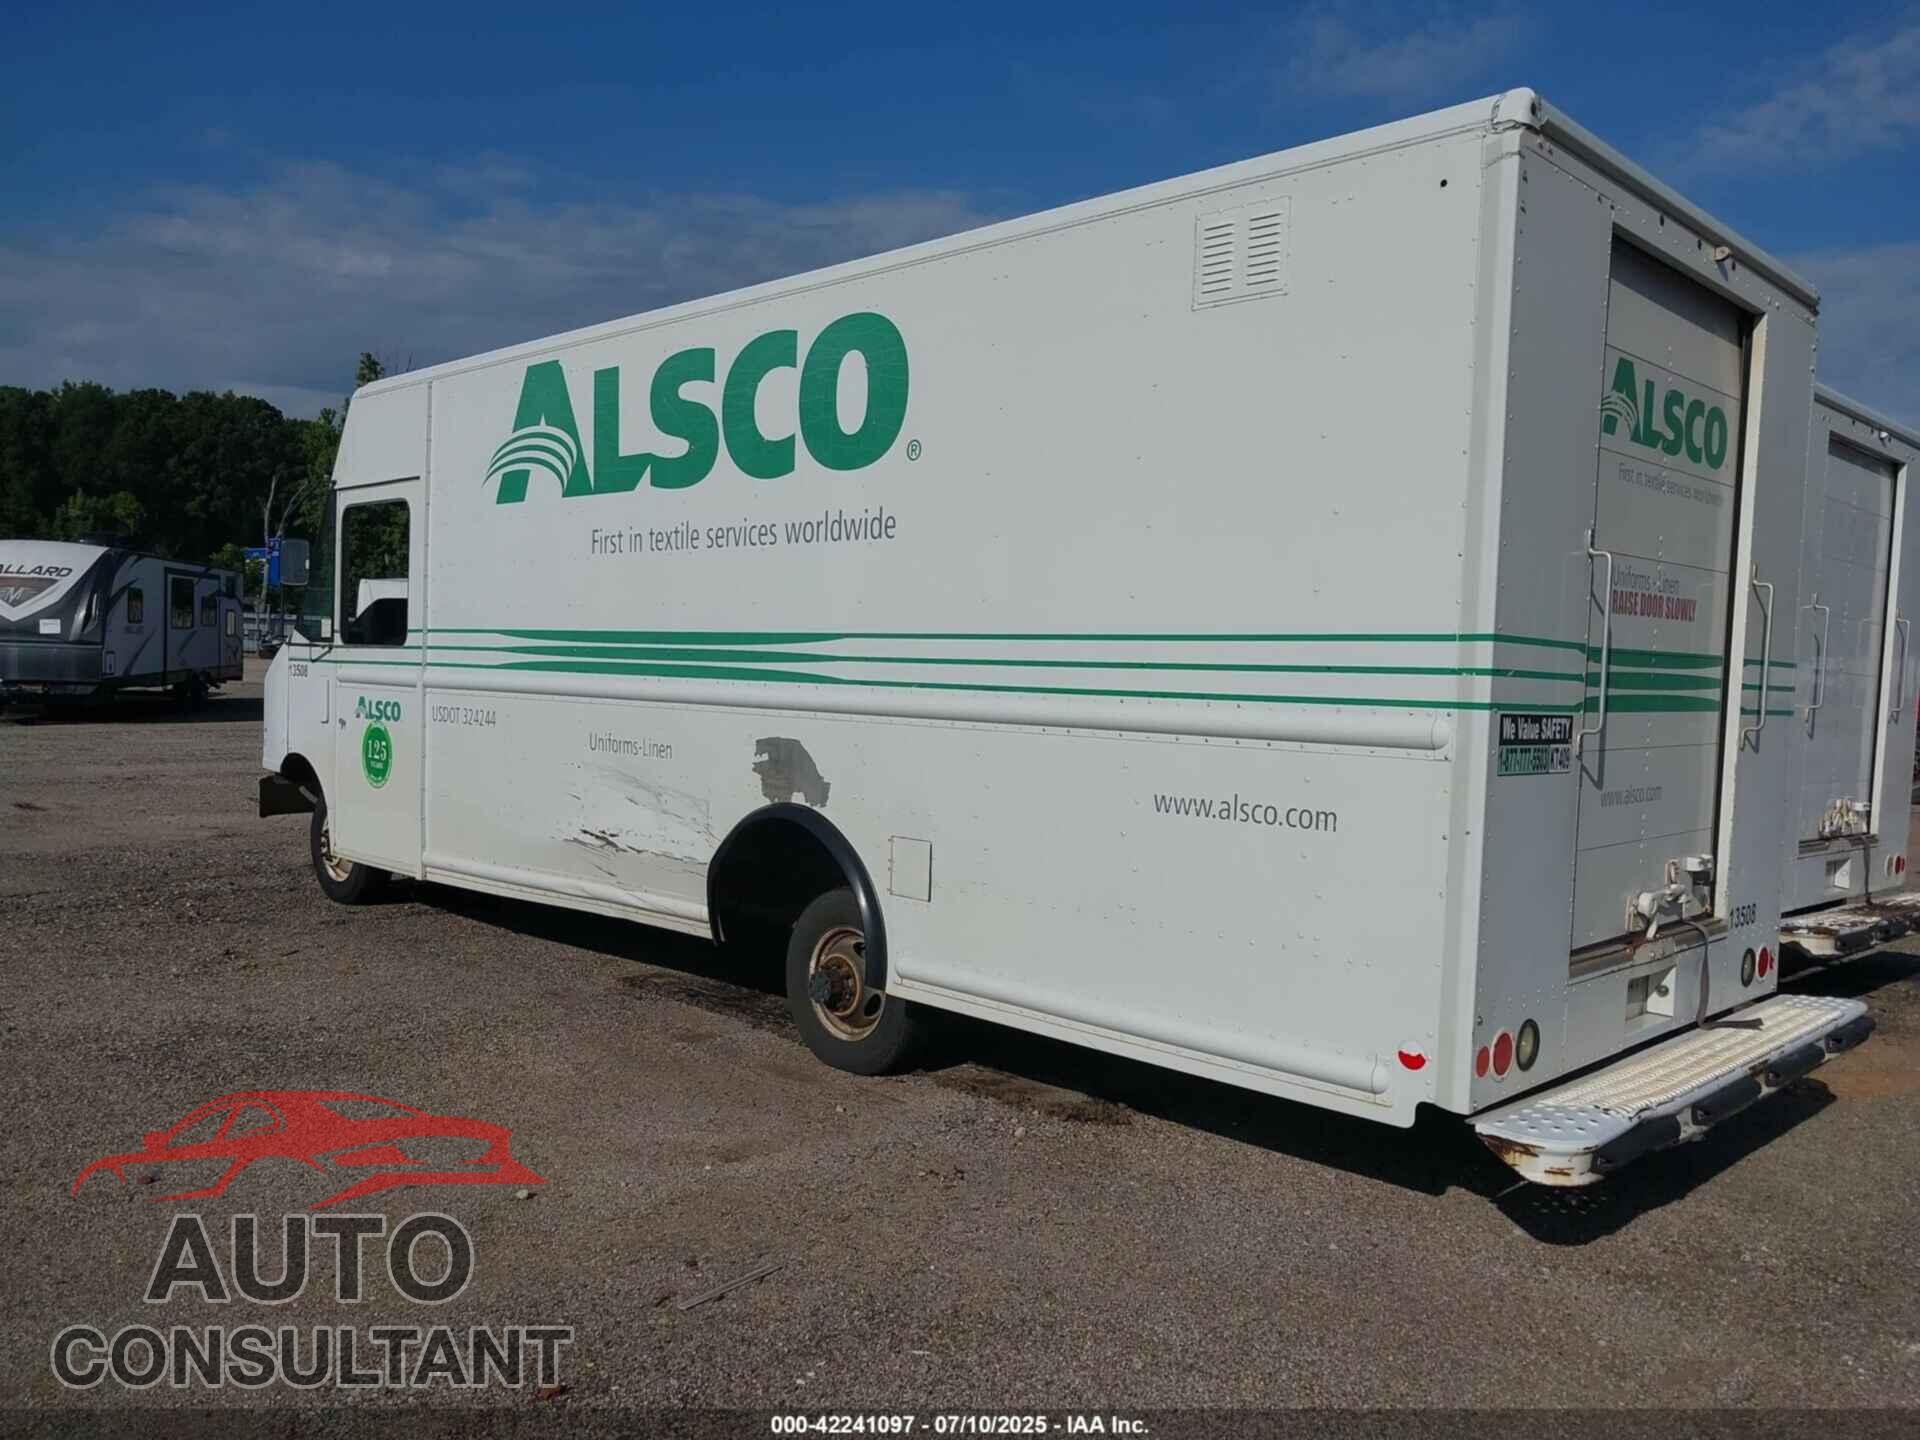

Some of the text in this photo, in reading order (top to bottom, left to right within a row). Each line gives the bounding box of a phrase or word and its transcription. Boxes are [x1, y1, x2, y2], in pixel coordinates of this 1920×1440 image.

[482, 312, 909, 505] ALSCO
[1601, 357, 1728, 470] ALSCO
[591, 506, 897, 554] First in textile services worldwide
[0, 564, 73, 577] LLARD
[355, 696, 401, 721] ALSCO
[432, 705, 497, 728] USDOT 324244
[1503, 717, 1571, 740] We Value SAFETY
[368, 740, 387, 761] 125
[1153, 793, 1338, 833] www.alsco.com
